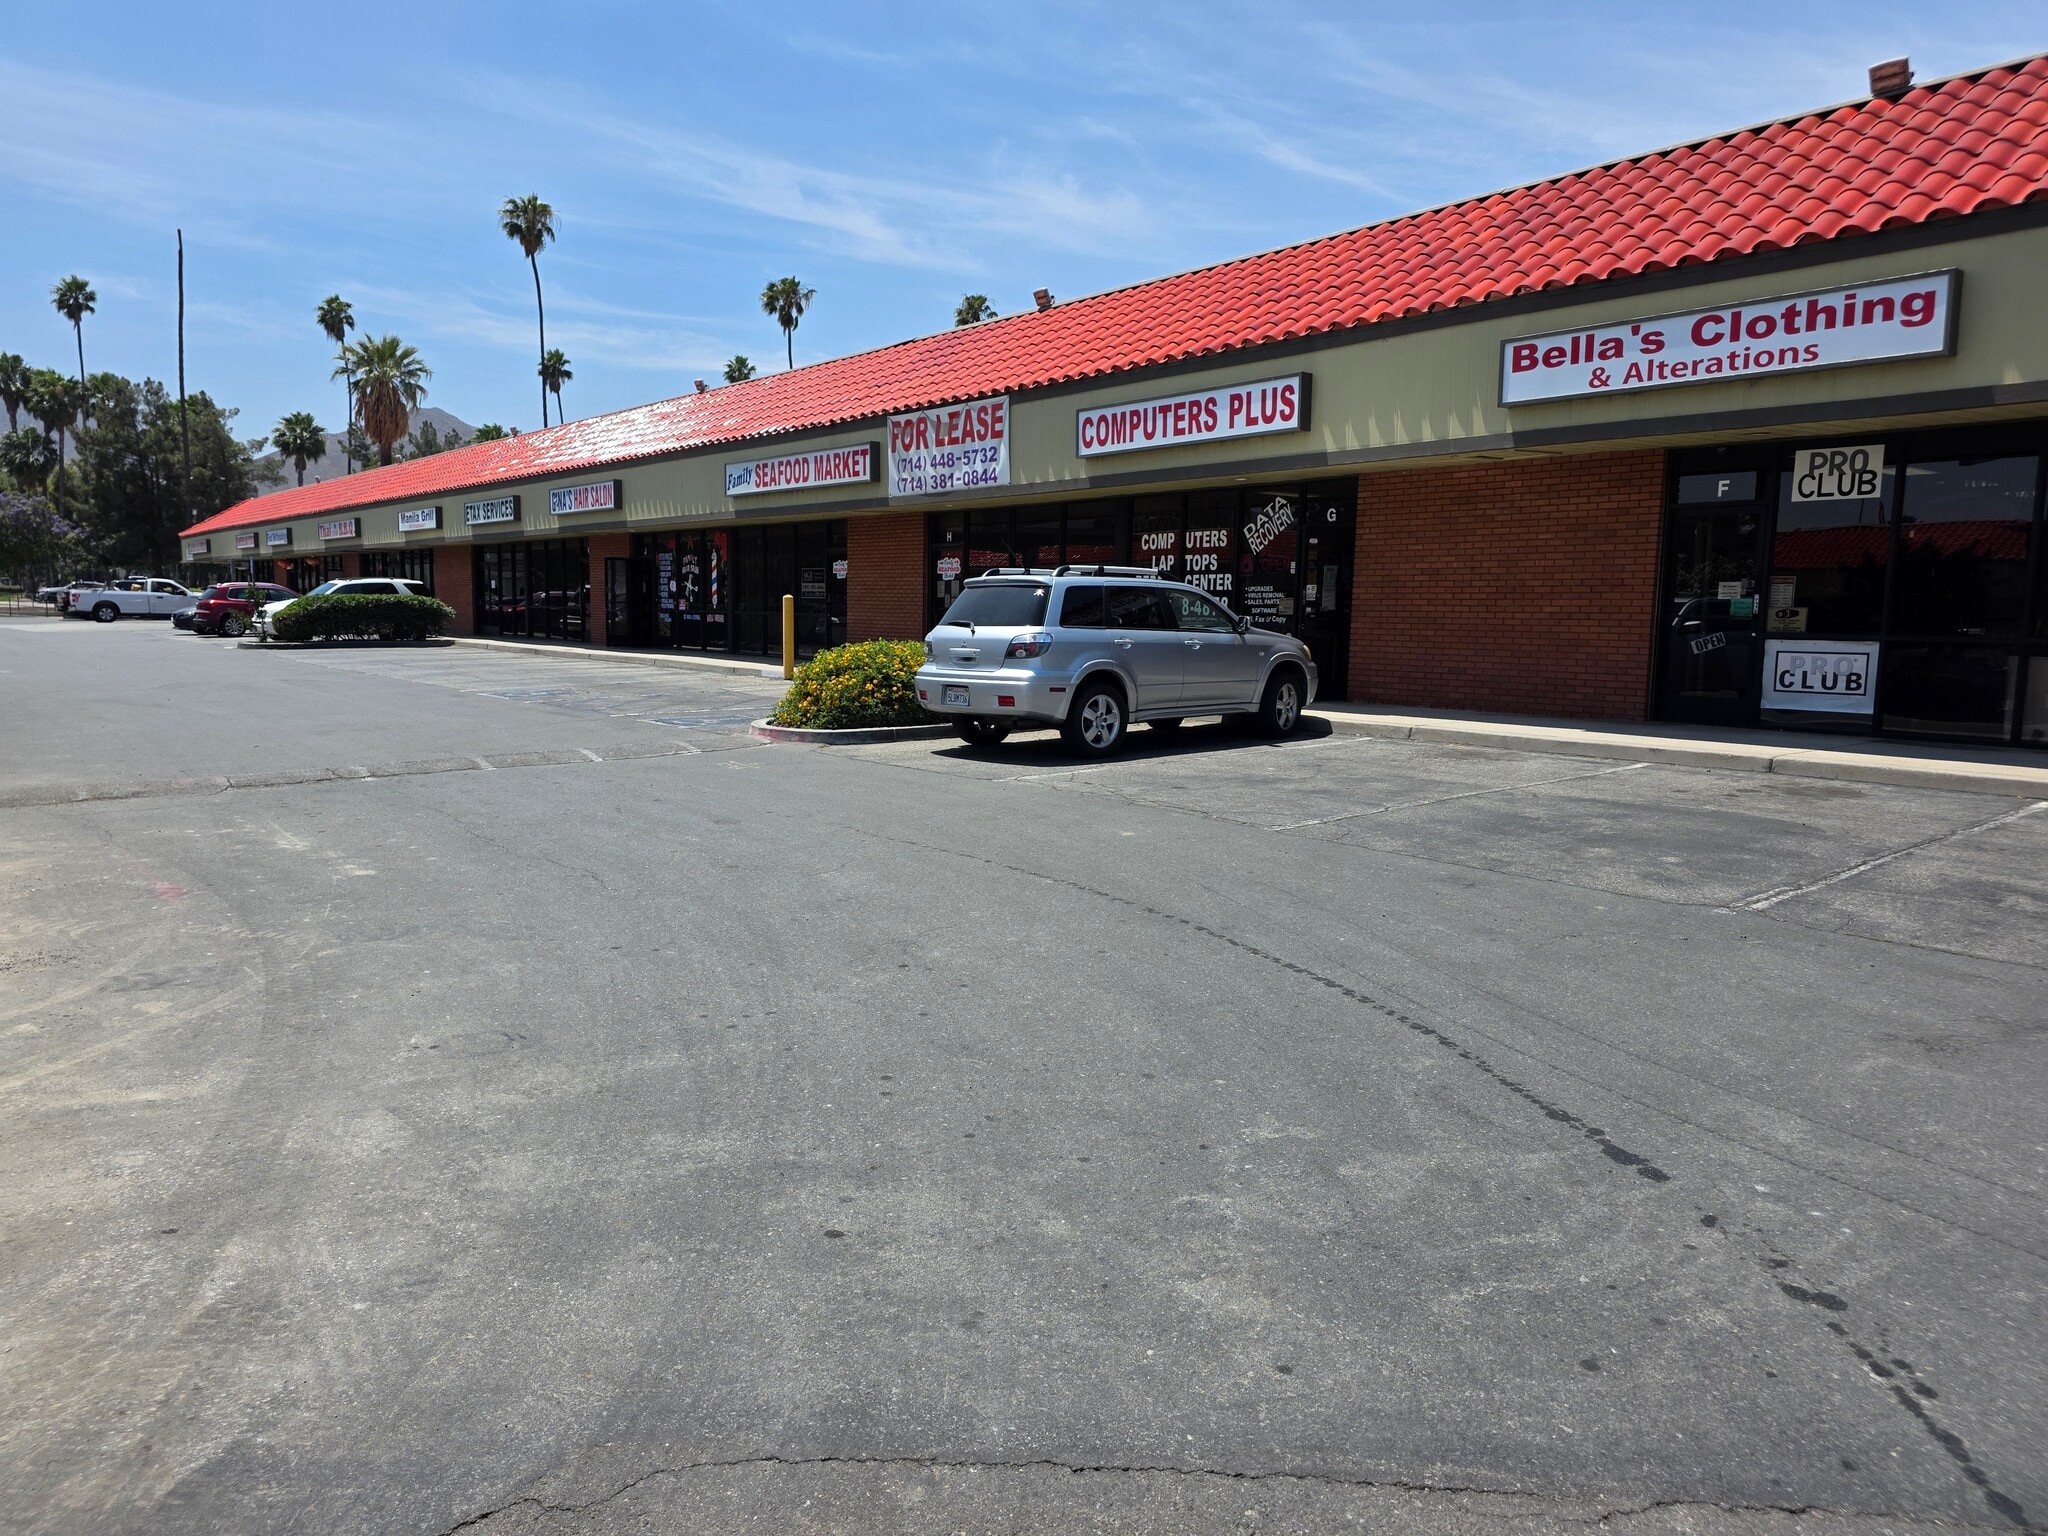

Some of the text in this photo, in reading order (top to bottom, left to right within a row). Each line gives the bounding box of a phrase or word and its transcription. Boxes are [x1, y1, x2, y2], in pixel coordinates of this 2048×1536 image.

[1511, 290, 1938, 374] Bella's Clothing
[1588, 343, 1820, 389] & Alterations
[891, 402, 1004, 453] FOR LEASE
[1081, 384, 1295, 449] COMPUTERS PLUS
[727, 448, 869, 491] Family SEAFOOD MARKET
[897, 446, 998, 474] (714) 448-5732
[1808, 448, 1869, 476] PRO
[897, 467, 998, 493] (714) 381-0844
[1717, 480, 1730, 498] F
[1798, 470, 1877, 498] CLUB
[573, 488, 590, 510] HAIR
[590, 483, 613, 508] SALON
[401, 509, 434, 524] Manila Grill
[465, 498, 513, 522] ETAX SERVICES
[1243, 496, 1288, 539] DATA
[1326, 508, 1337, 521] G
[946, 531, 952, 542] H
[1141, 529, 1228, 550] COMP UTERS
[1248, 503, 1294, 556] RECOVERY
[1152, 554, 1218, 572] LAP TOPS
[1184, 573, 1233, 590] CENTER
[1271, 616, 1287, 624] Copy
[1694, 633, 1725, 652] OPEN
[1789, 655, 1854, 676] PRO
[1778, 669, 1863, 691] CLUB
